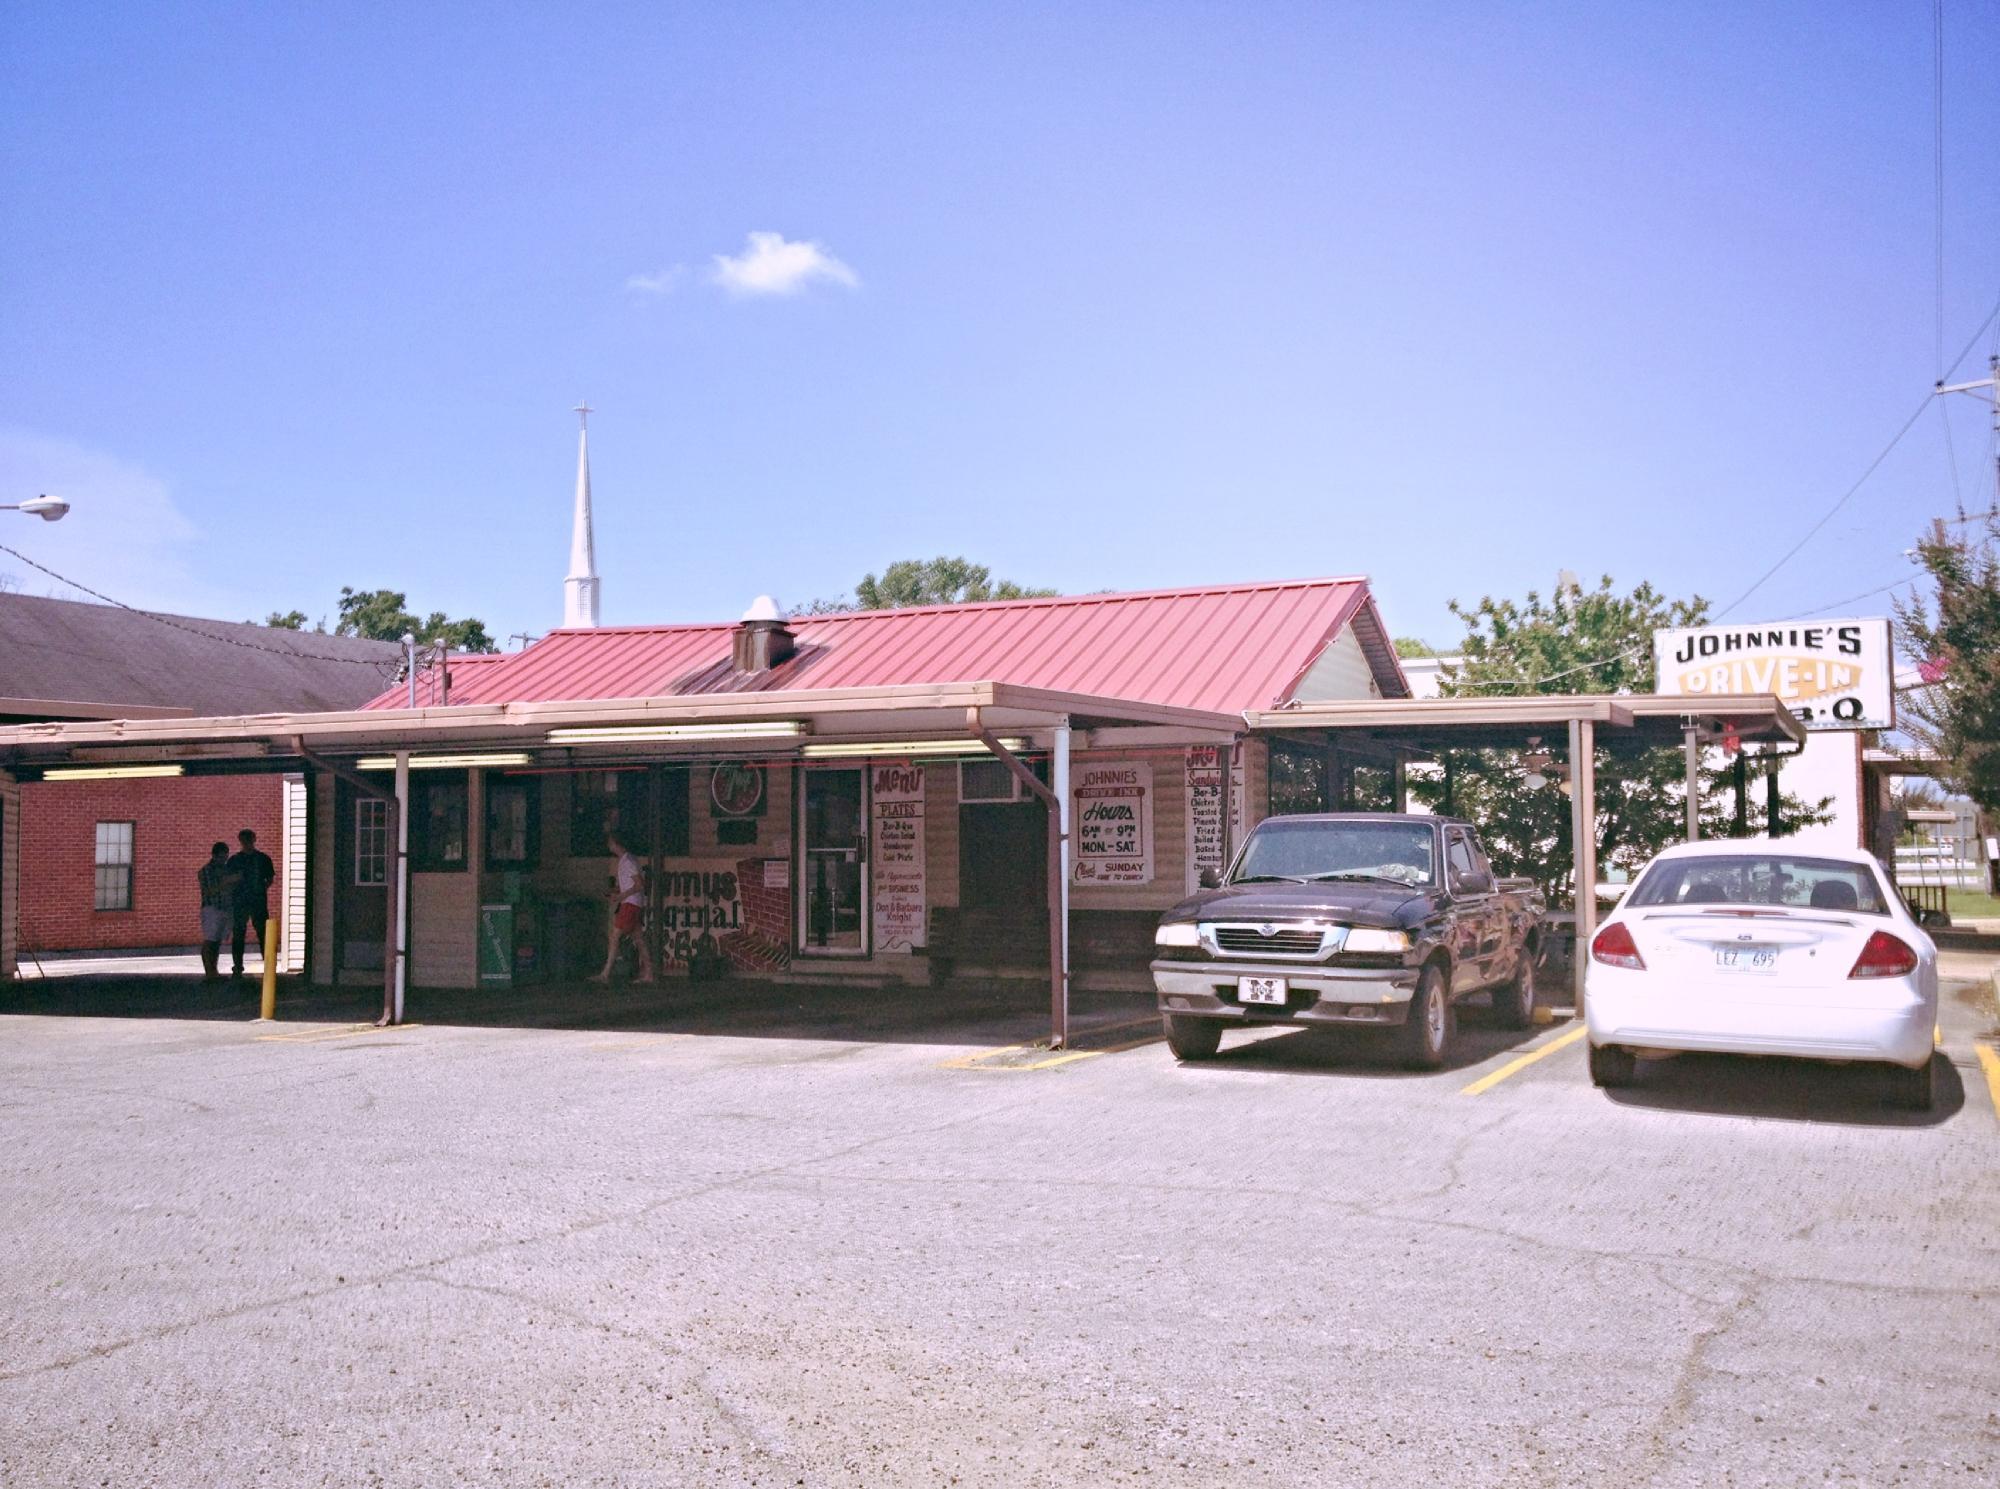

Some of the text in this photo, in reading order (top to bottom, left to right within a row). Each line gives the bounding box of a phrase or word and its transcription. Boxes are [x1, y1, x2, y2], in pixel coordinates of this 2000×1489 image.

[1676, 626, 1862, 663] JOHNNIE'S
[880, 804, 916, 817] PLATES
[1083, 802, 1135, 821] Hours
[1105, 863, 1144, 872] SUNDAY
